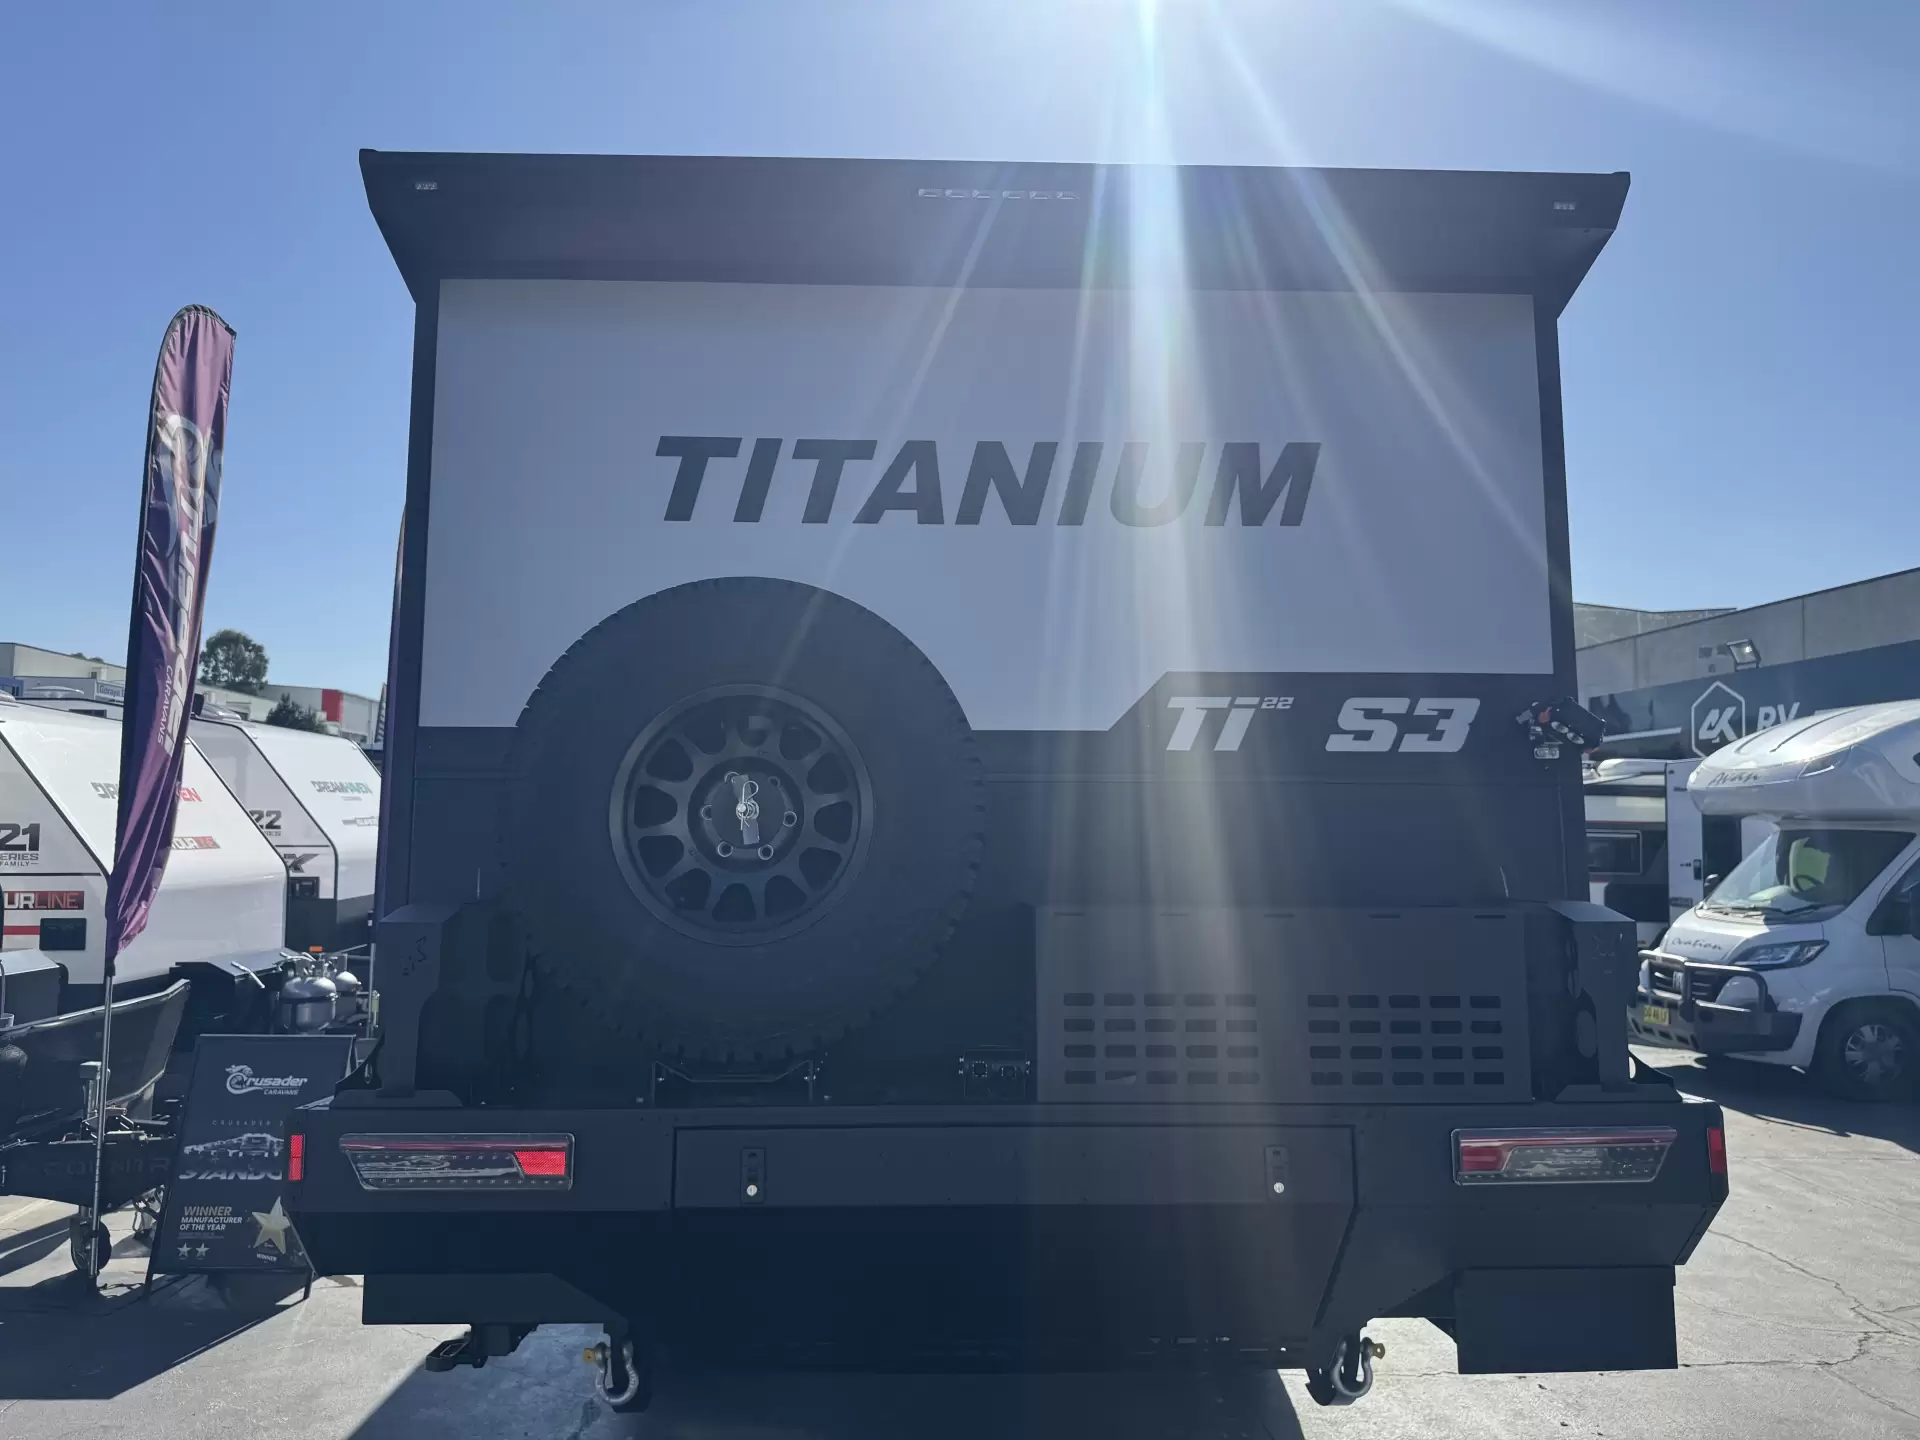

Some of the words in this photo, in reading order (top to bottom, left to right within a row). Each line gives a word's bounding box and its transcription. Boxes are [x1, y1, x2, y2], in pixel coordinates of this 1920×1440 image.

[655, 435, 1322, 528] TITANIUM
[157, 664, 173, 745] CARAVANS
[1325, 697, 1481, 753] S3
[1756, 702, 1801, 733] RV
[0, 823, 41, 852] 21
[0, 852, 39, 861] ERIES
[4, 892, 80, 910] URLINE
[226, 1072, 308, 1095] Crusader
[263, 1088, 299, 1096] CARAVANS
[180, 1216, 244, 1224] MANUFACTURER
[183, 1205, 233, 1217] WINNER
[179, 1223, 190, 1231] OF
[191, 1223, 205, 1231] THE
[206, 1223, 227, 1231] YEAR
[256, 1253, 278, 1263] WINNER
